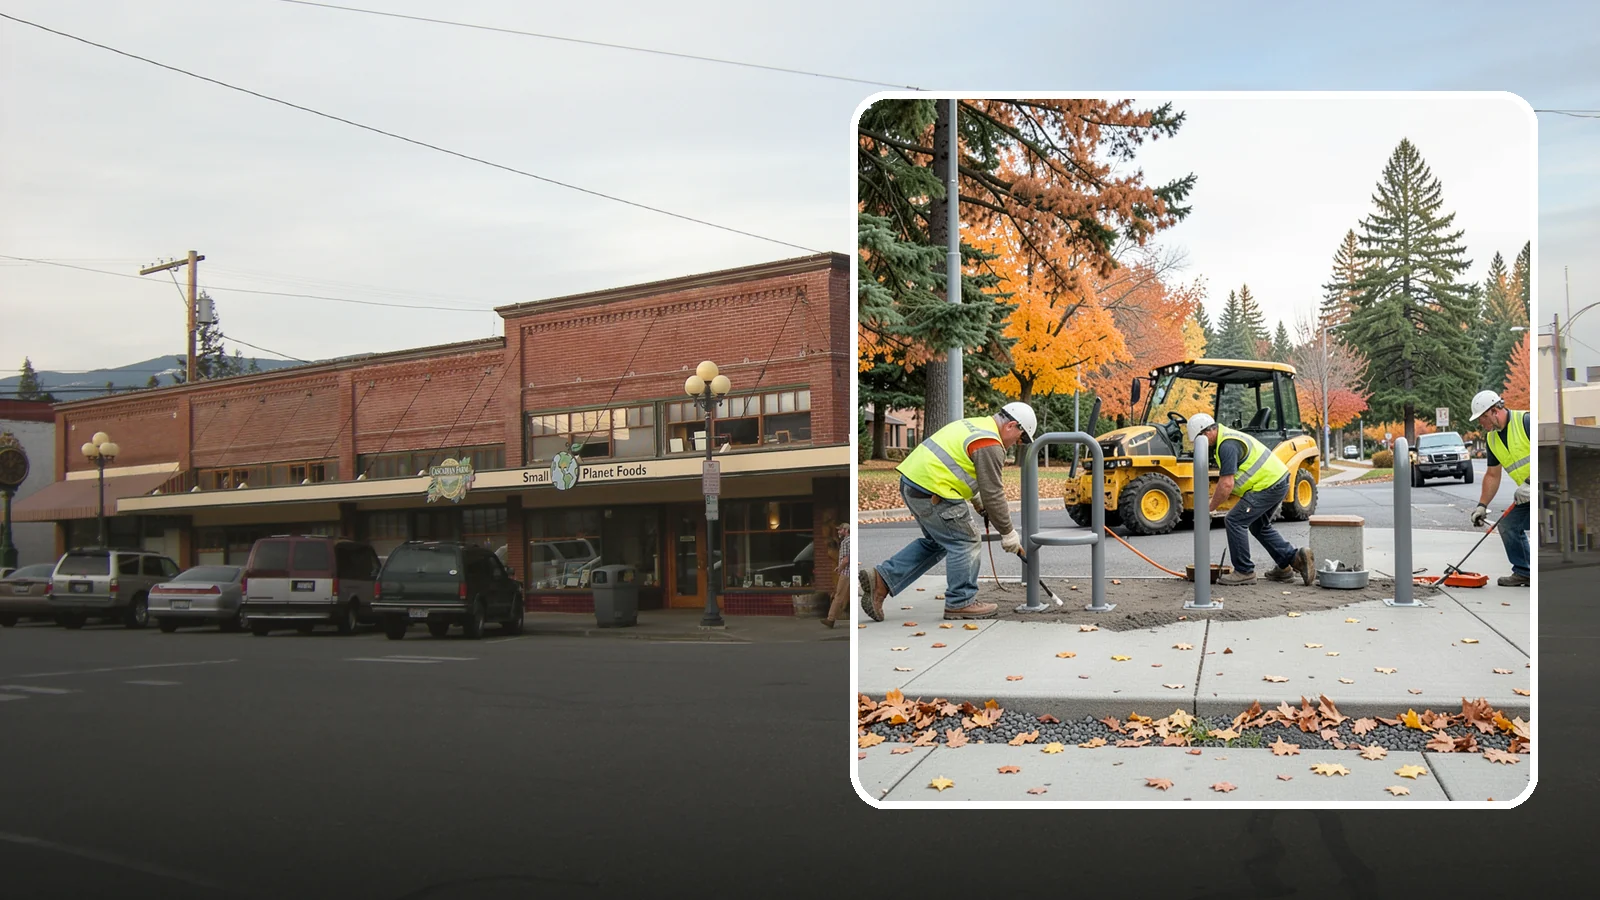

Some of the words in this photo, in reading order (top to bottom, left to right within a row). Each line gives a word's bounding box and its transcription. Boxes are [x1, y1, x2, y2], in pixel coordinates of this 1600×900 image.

[523, 471, 549, 483] Small
[583, 467, 614, 479] Planet
[617, 464, 647, 477] Foods
